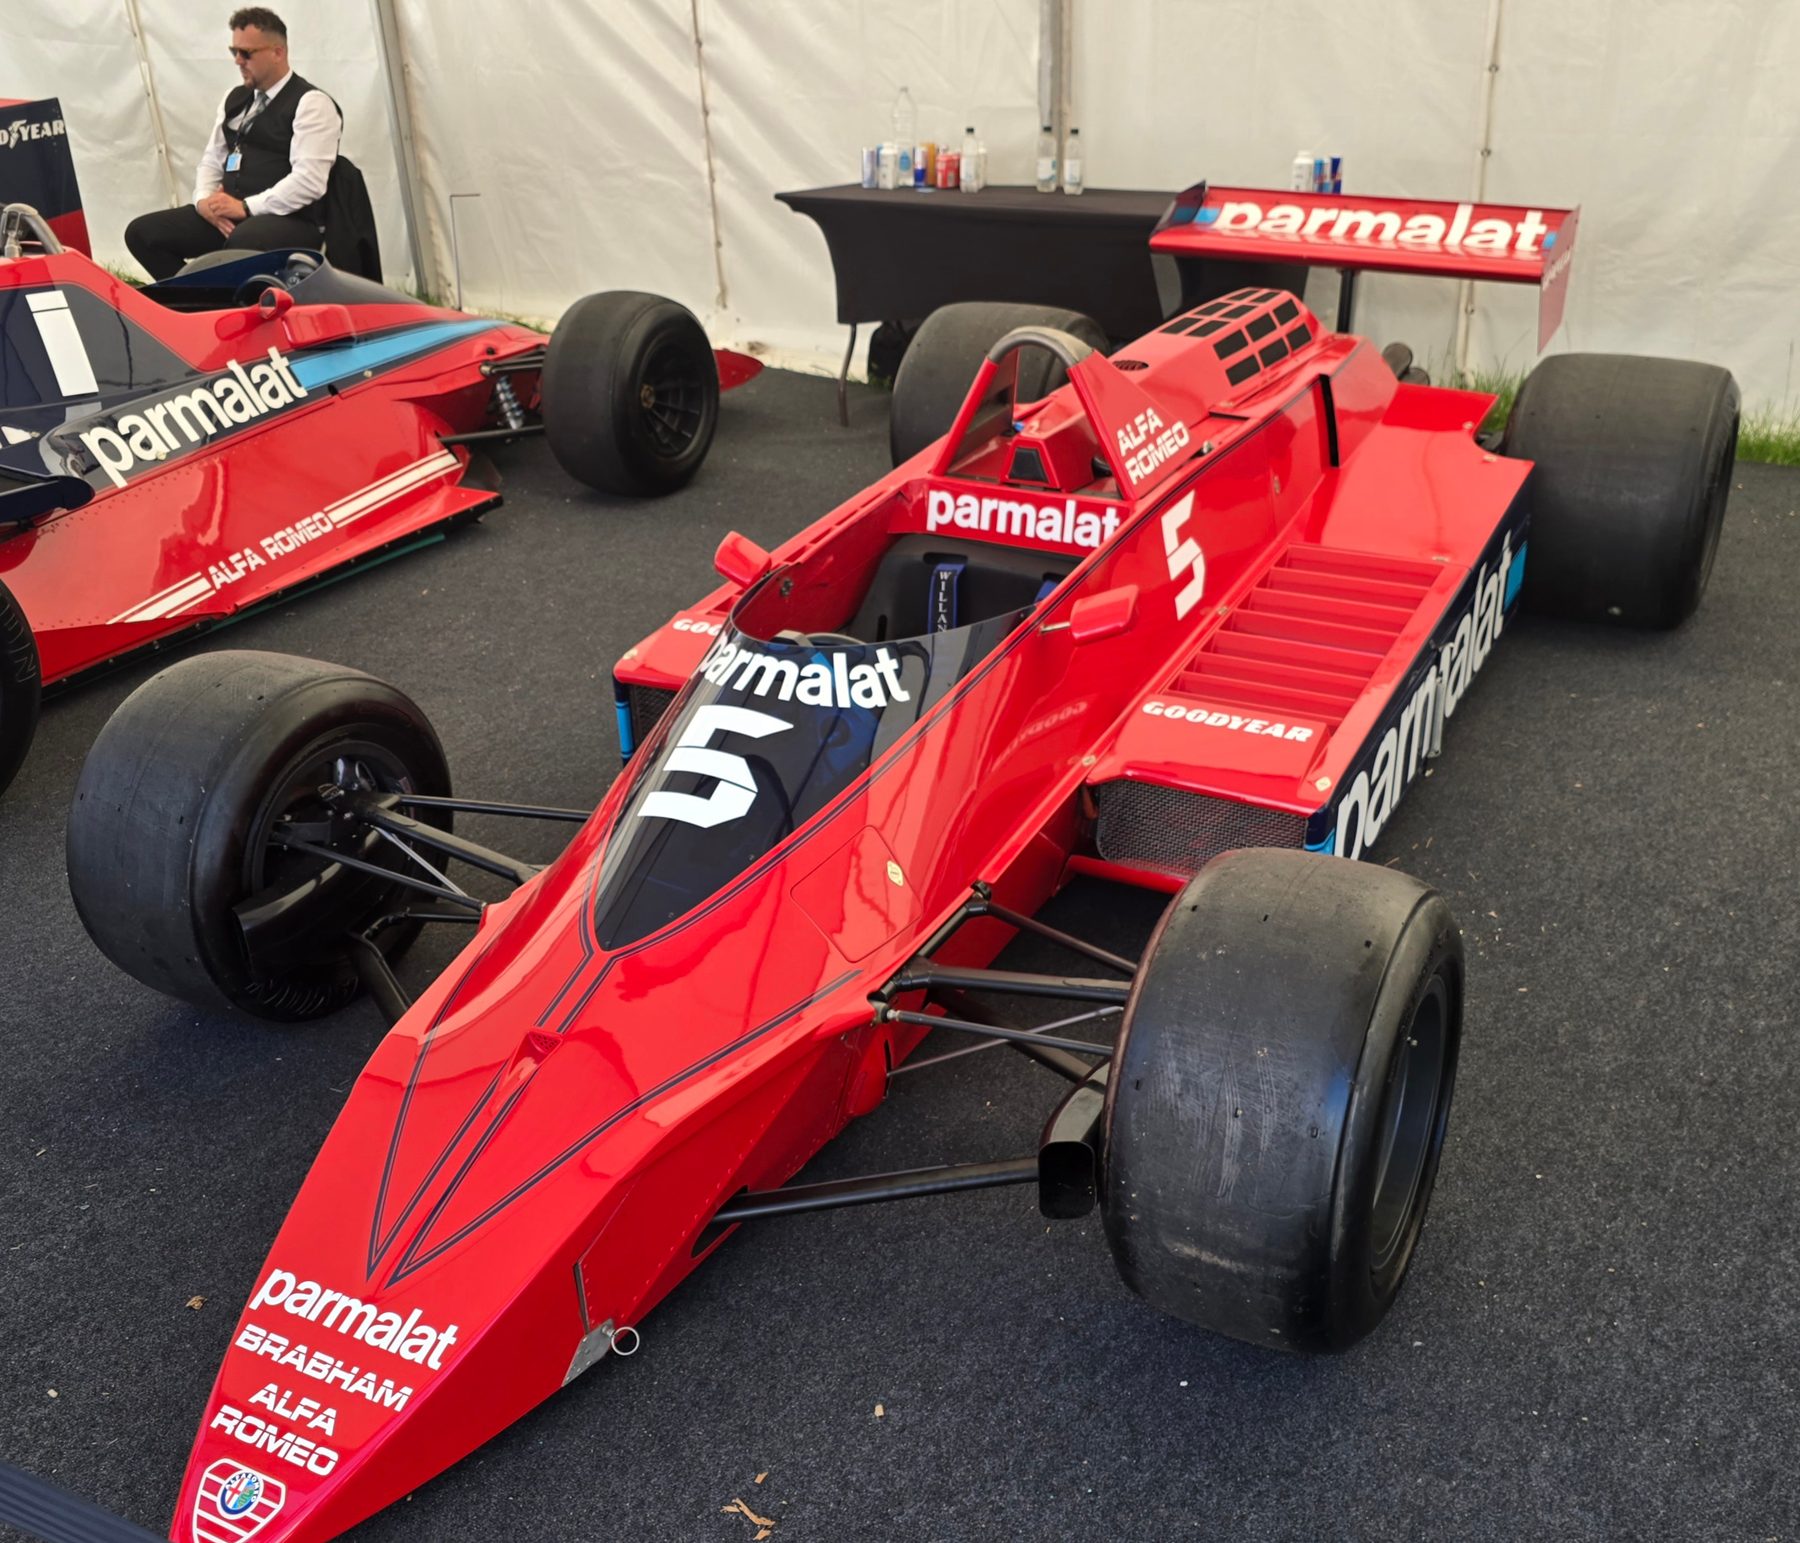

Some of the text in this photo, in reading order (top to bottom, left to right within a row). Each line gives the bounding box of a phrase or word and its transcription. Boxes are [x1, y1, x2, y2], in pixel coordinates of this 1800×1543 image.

[1210, 200, 1548, 252] parmalat
[79, 347, 307, 488] parmalat
[1116, 407, 1163, 457] ALFA
[1125, 420, 1190, 486] ROMEO
[208, 511, 334, 590] ALFA ROMEO
[926, 489, 1120, 549] parmalat
[1160, 489, 1206, 621] 5
[1142, 701, 1314, 743] GOODYEAR
[1334, 529, 1513, 861] parmalat
[637, 704, 794, 829] 5
[248, 1268, 459, 1371] parmalat
[234, 1323, 413, 1413] BRABHAM
[210, 1404, 339, 1477] ROMEO
[248, 1383, 338, 1437] ALFA
